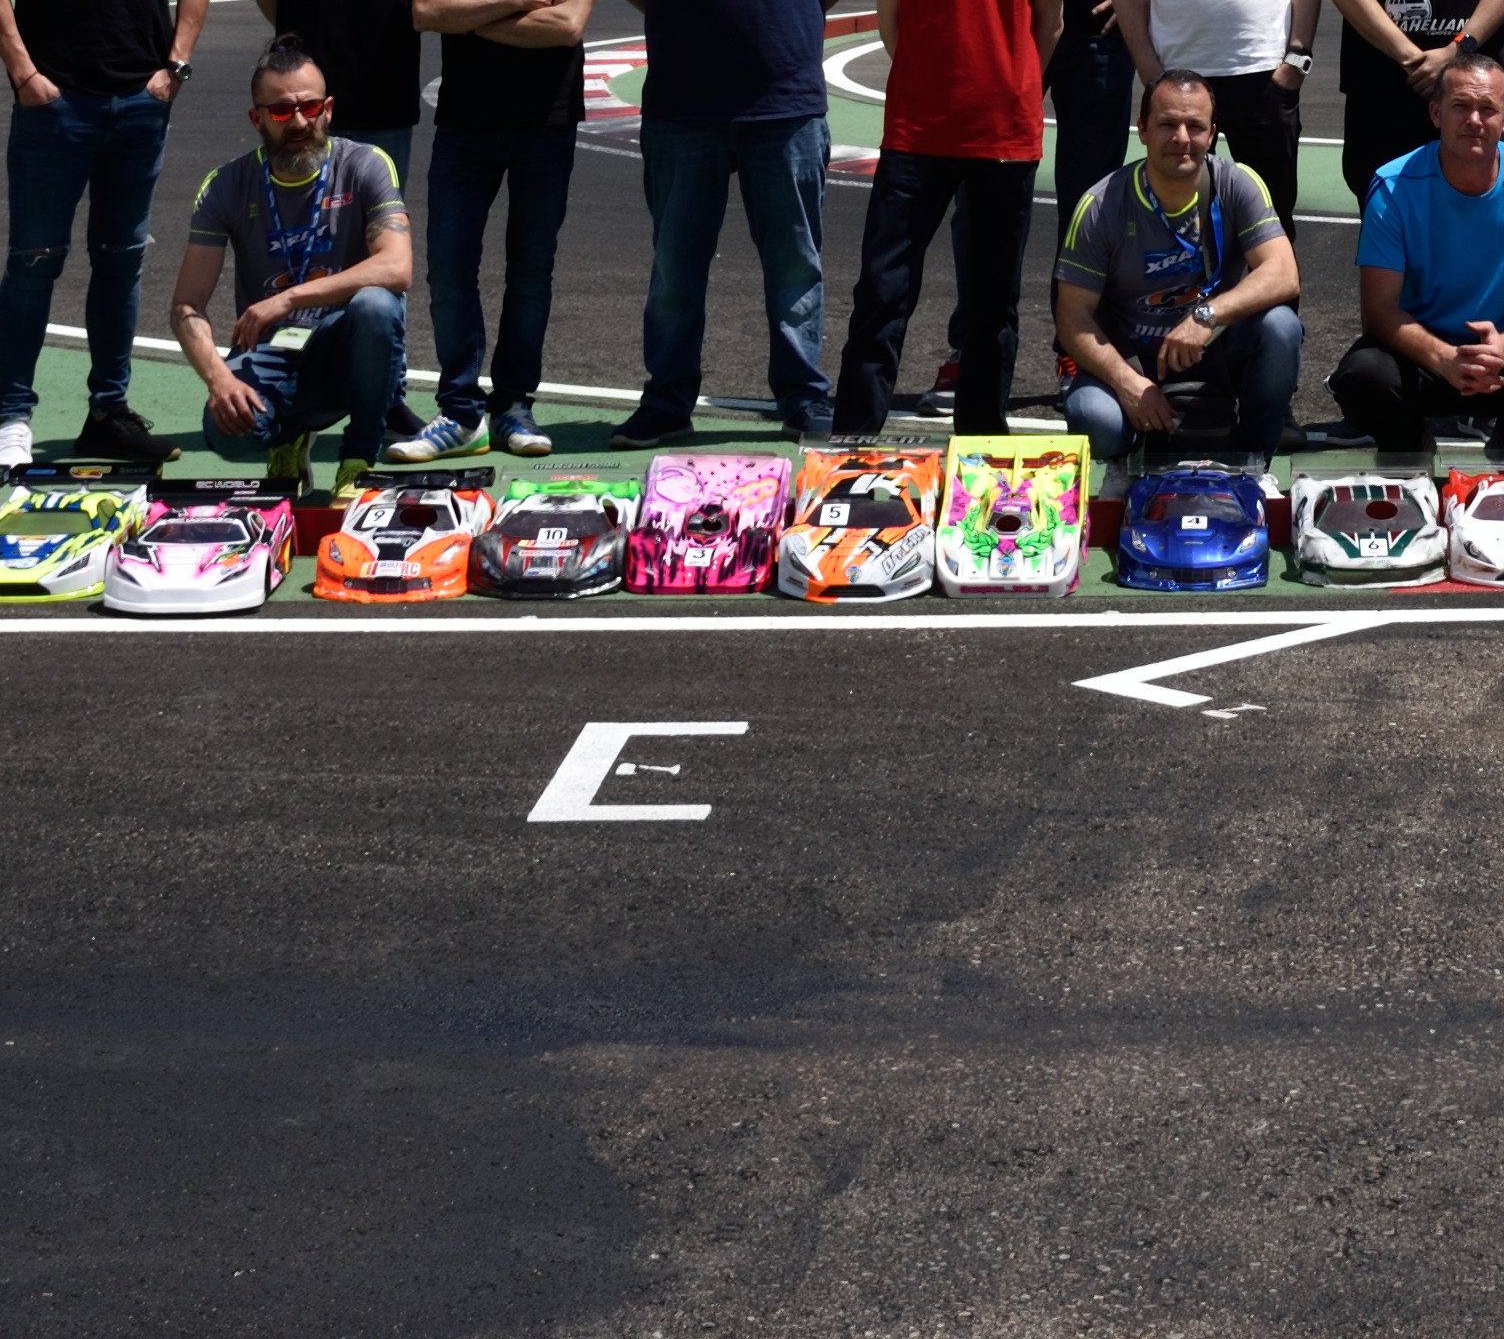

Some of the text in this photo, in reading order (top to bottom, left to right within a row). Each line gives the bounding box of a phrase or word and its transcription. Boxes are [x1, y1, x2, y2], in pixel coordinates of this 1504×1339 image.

[1399, 17, 1470, 34] AHELIAN
[1145, 249, 1194, 274] XRA
[373, 509, 386, 522] 9
[829, 505, 842, 519] 5
[544, 529, 564, 540] 10
[1368, 538, 1380, 550] 6
[401, 562, 420, 577] RC
